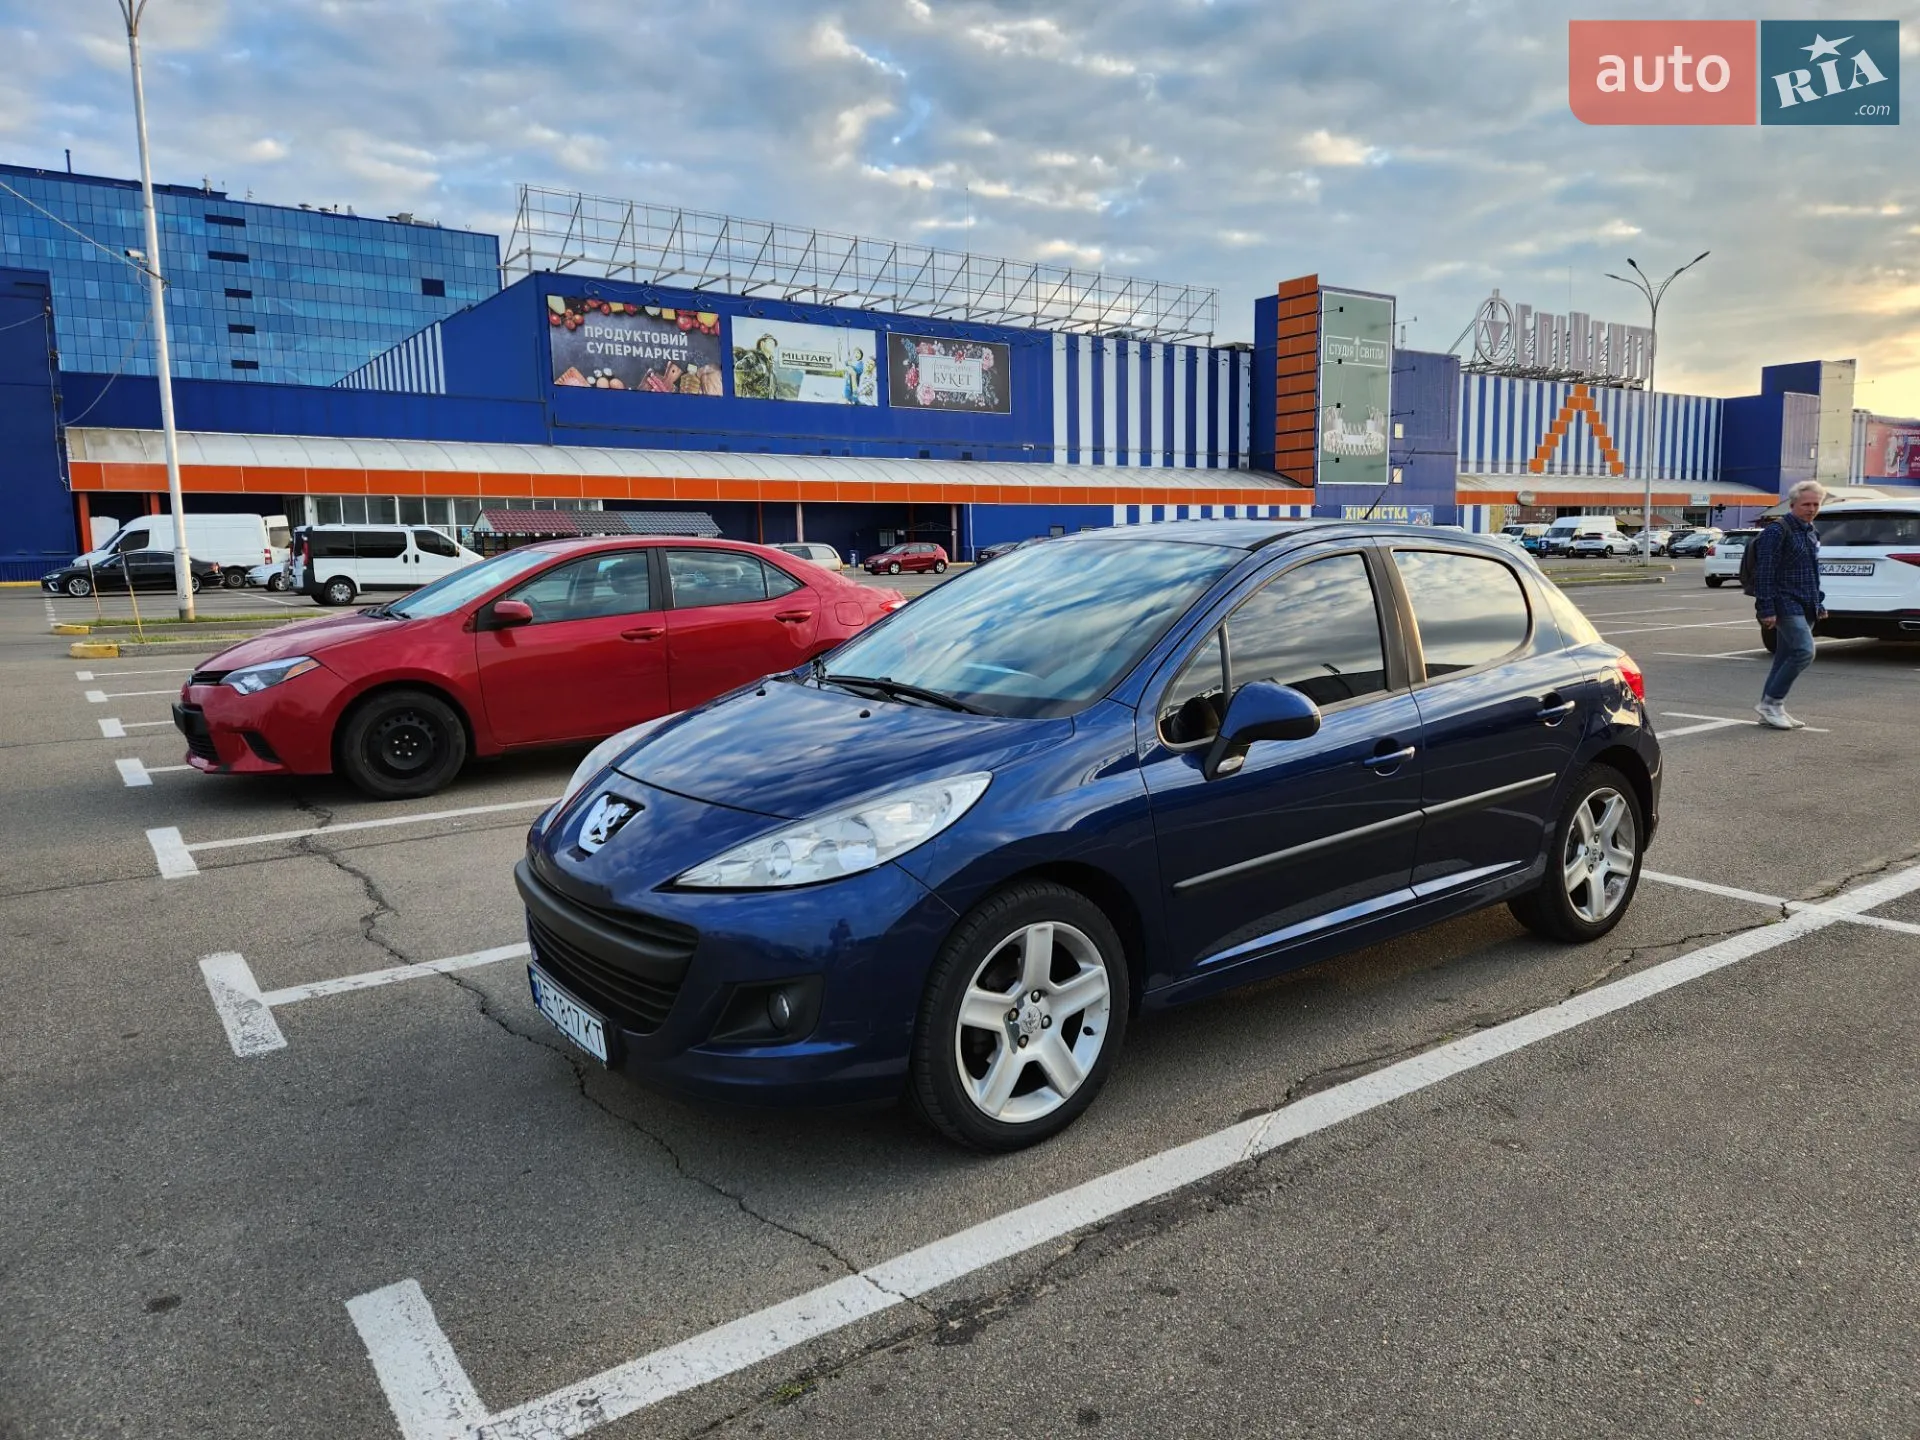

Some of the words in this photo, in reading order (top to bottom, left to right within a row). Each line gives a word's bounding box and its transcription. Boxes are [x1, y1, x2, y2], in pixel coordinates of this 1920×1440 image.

[584, 325, 688, 347] ПРОДУКТОВИЙ
[586, 341, 688, 361] СУПЕРМАРКЕТ
[782, 351, 832, 363] MILITARY
[1328, 344, 1354, 358] СТУДІЯ
[1360, 346, 1384, 360] СВІТЛА
[934, 372, 973, 387] БУКЕТ
